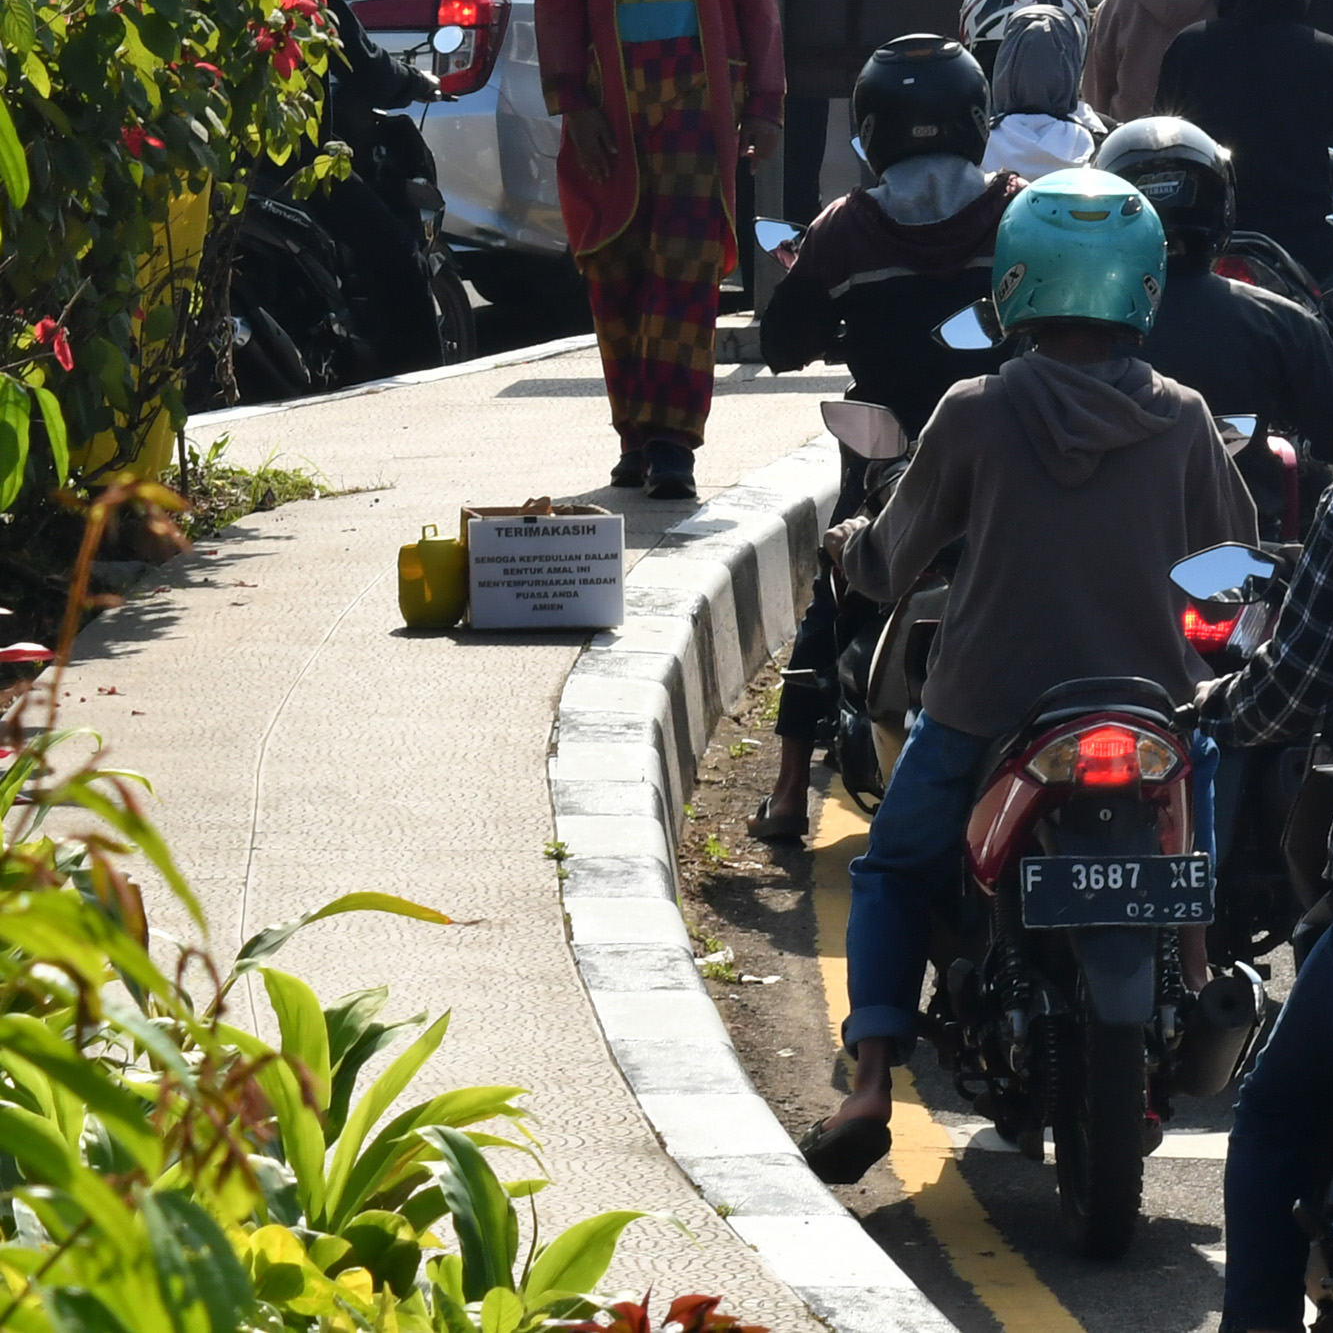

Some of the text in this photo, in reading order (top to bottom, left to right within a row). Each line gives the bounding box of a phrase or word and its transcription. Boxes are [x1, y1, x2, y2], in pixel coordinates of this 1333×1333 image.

[495, 524, 597, 538] TERIMAKASIH
[475, 553, 618, 564] SEMOGA KEPEDULIAN DALAM
[503, 565, 590, 576] BENTUK AMAL INI
[478, 577, 616, 588] MENYEMPURNAKAN IBADAH
[516, 590, 579, 600] PUASA ANDA
[531, 603, 563, 611] AMIEN
[1026, 861, 1206, 892] F 3687 XE
